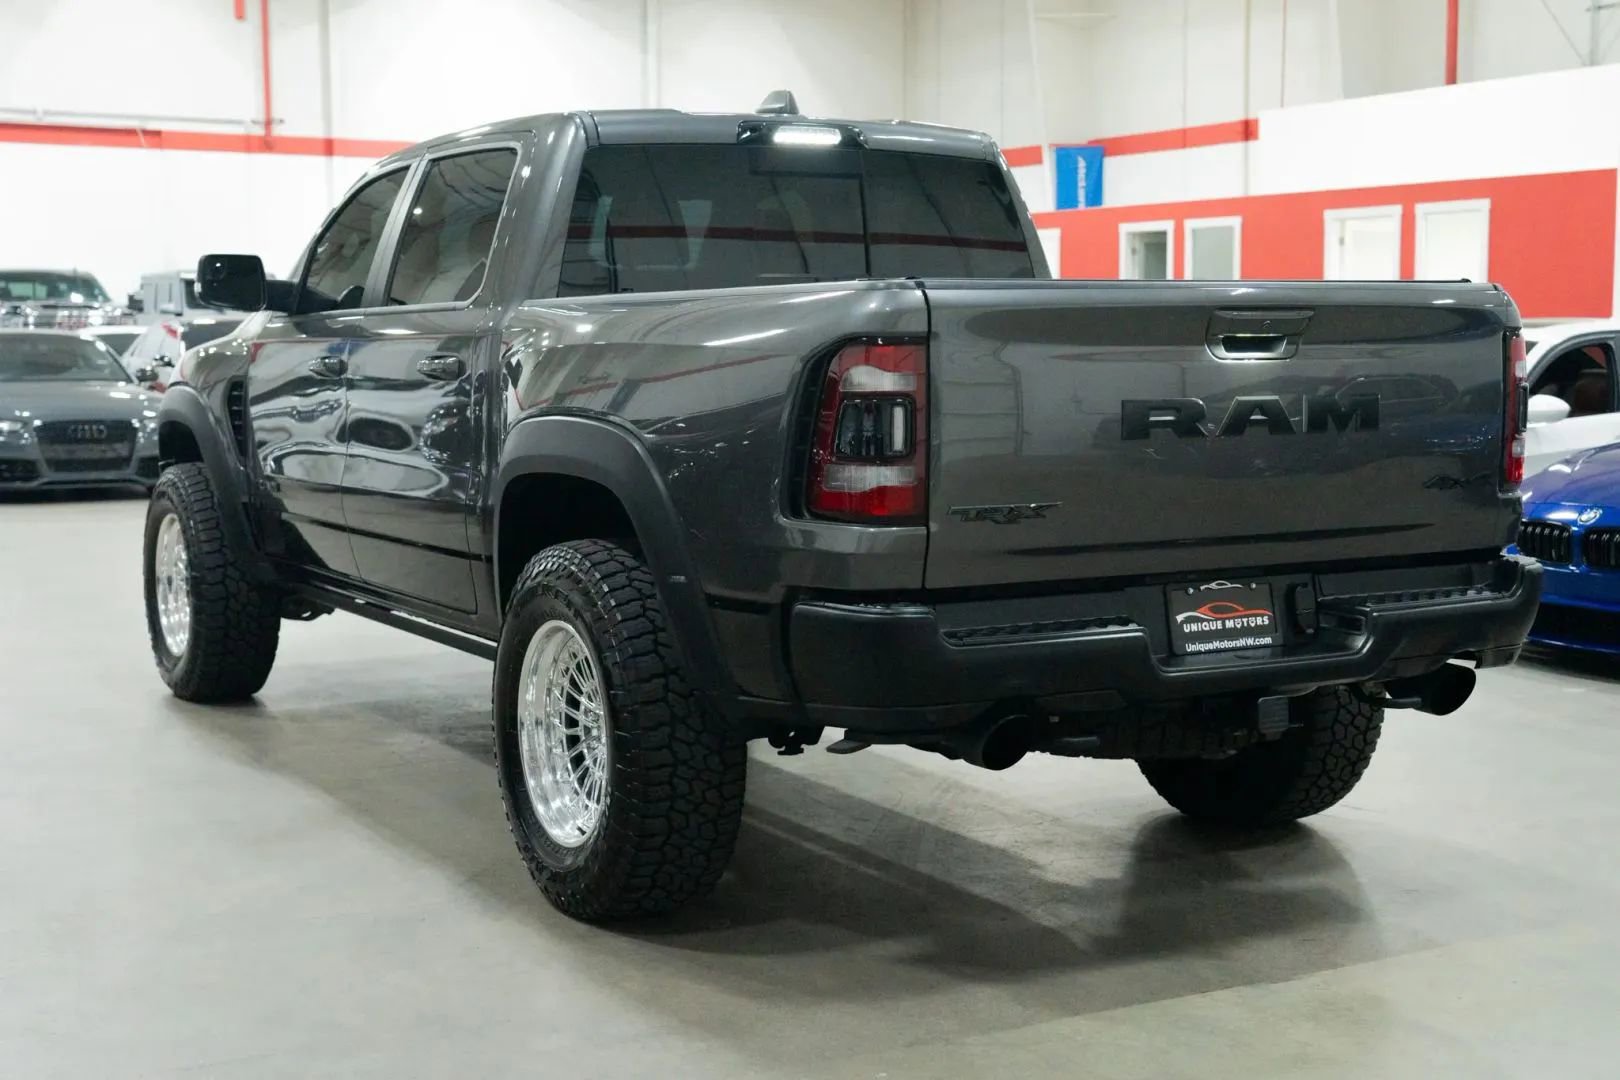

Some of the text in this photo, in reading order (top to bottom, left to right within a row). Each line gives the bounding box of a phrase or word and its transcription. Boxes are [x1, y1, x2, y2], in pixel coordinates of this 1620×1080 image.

[1121, 395, 1381, 440] RAM
[1183, 616, 1270, 633] UNIQUE MOTORS
[1185, 636, 1272, 652] UniqueMotorsNW.com
